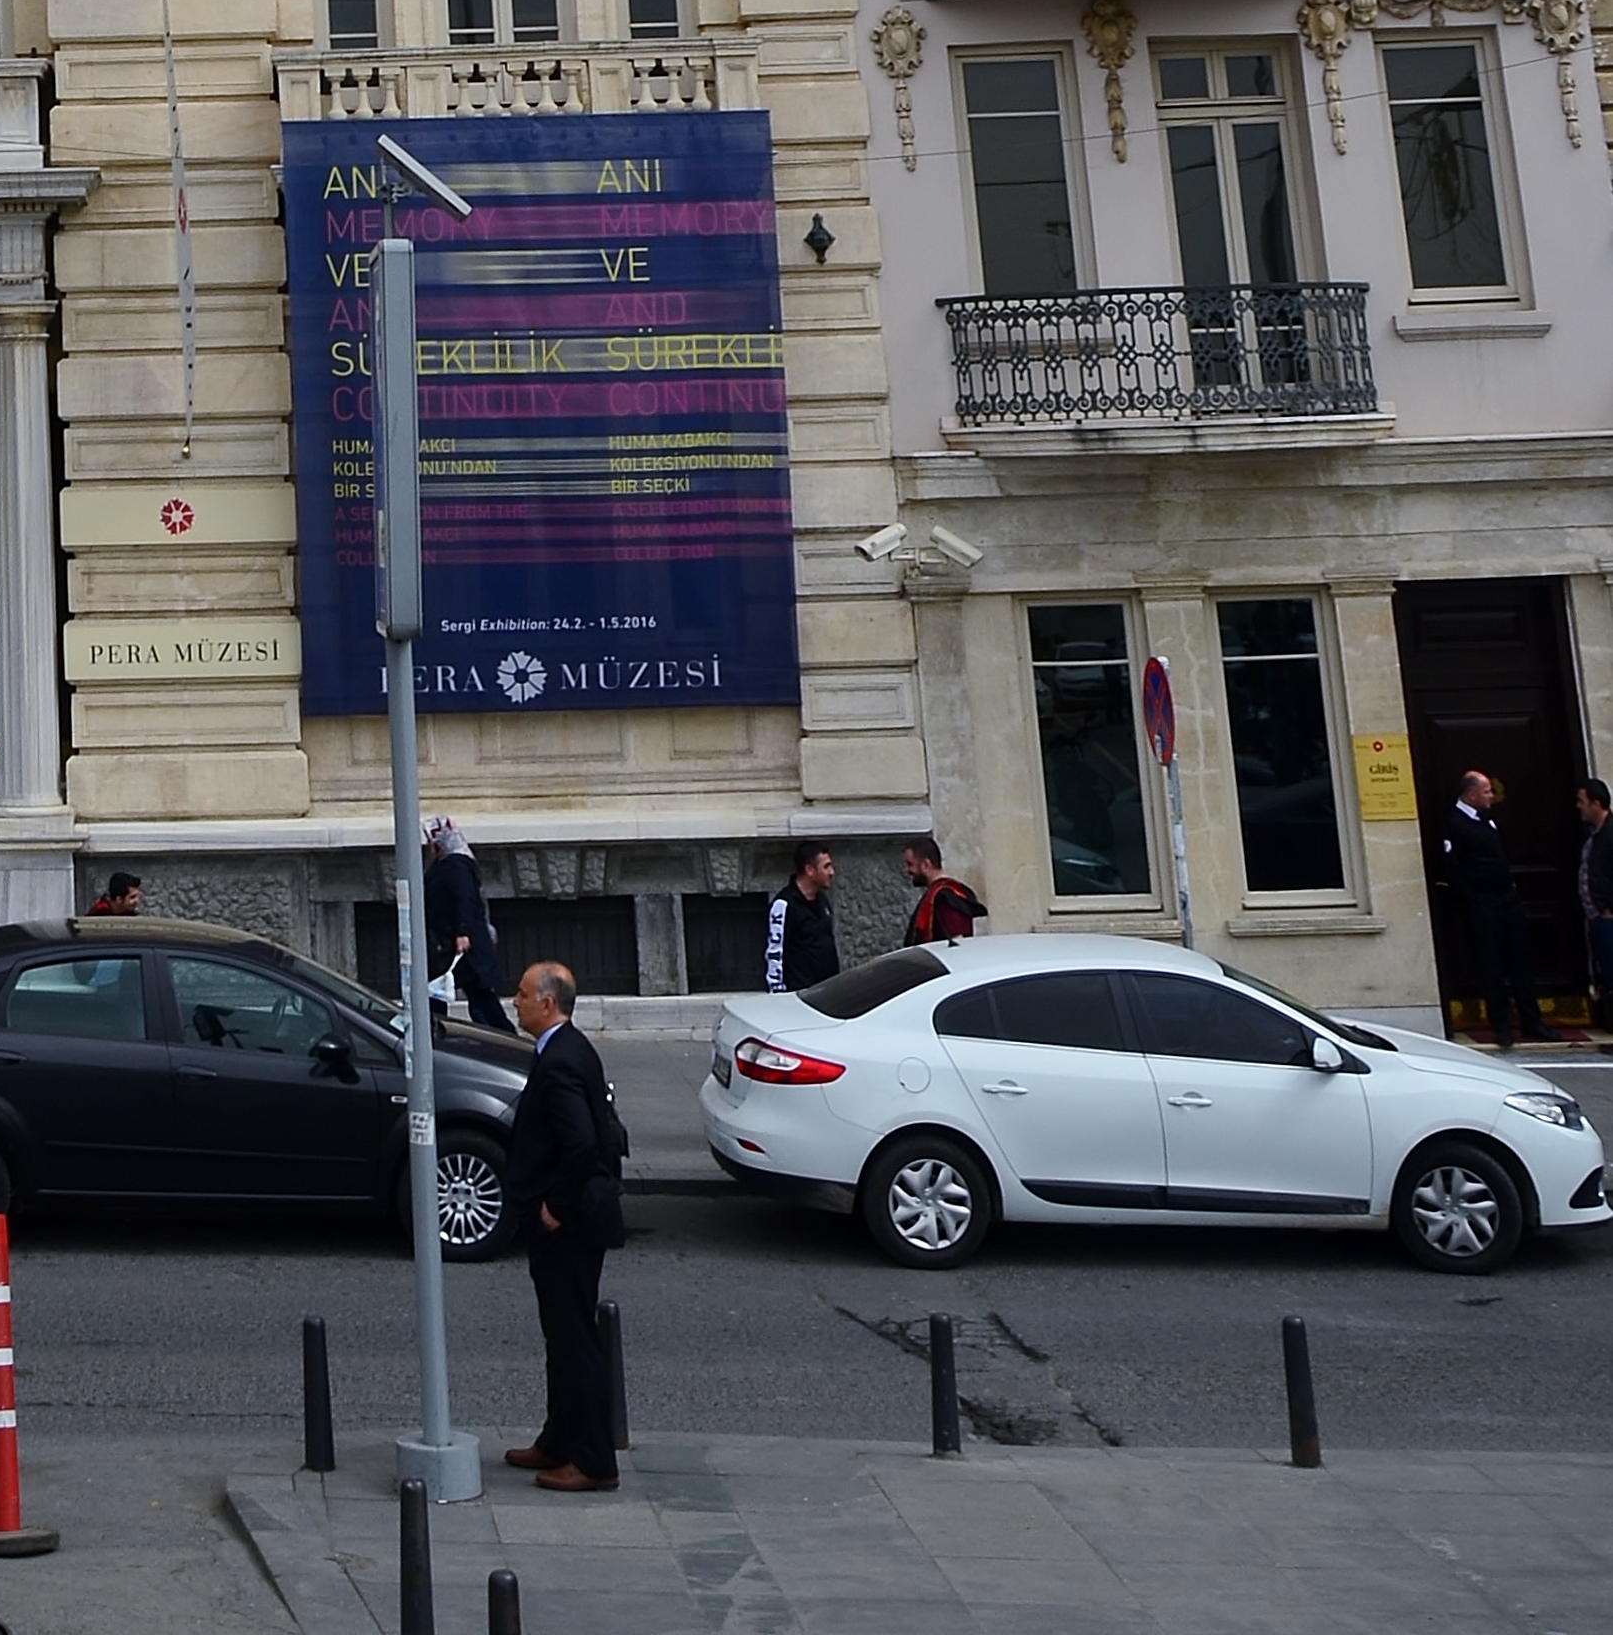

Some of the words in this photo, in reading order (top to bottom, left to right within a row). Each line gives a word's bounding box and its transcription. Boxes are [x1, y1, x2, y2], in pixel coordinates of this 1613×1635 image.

[596, 158, 662, 194] ANI
[599, 201, 770, 237] MEMORY
[600, 247, 651, 282] VE
[330, 298, 373, 332] AN
[604, 291, 687, 326] AND
[331, 330, 567, 377] SÜEKLİLİK
[331, 383, 569, 422] COTINUITY
[609, 434, 658, 451] HUMA
[609, 451, 774, 473] KOLEKSİYONU'NDAN
[333, 479, 361, 499] BİR
[611, 474, 638, 495] BİR
[643, 473, 691, 496] SEÇKİ
[440, 619, 477, 634] Sergi
[479, 617, 551, 631] Exhibition:
[553, 617, 587, 630] 24.2.
[599, 616, 657, 630] 1.5.2016
[89, 643, 162, 664] PERA
[173, 637, 281, 664] MÜZESİ
[560, 653, 724, 690] MÜZESİ
